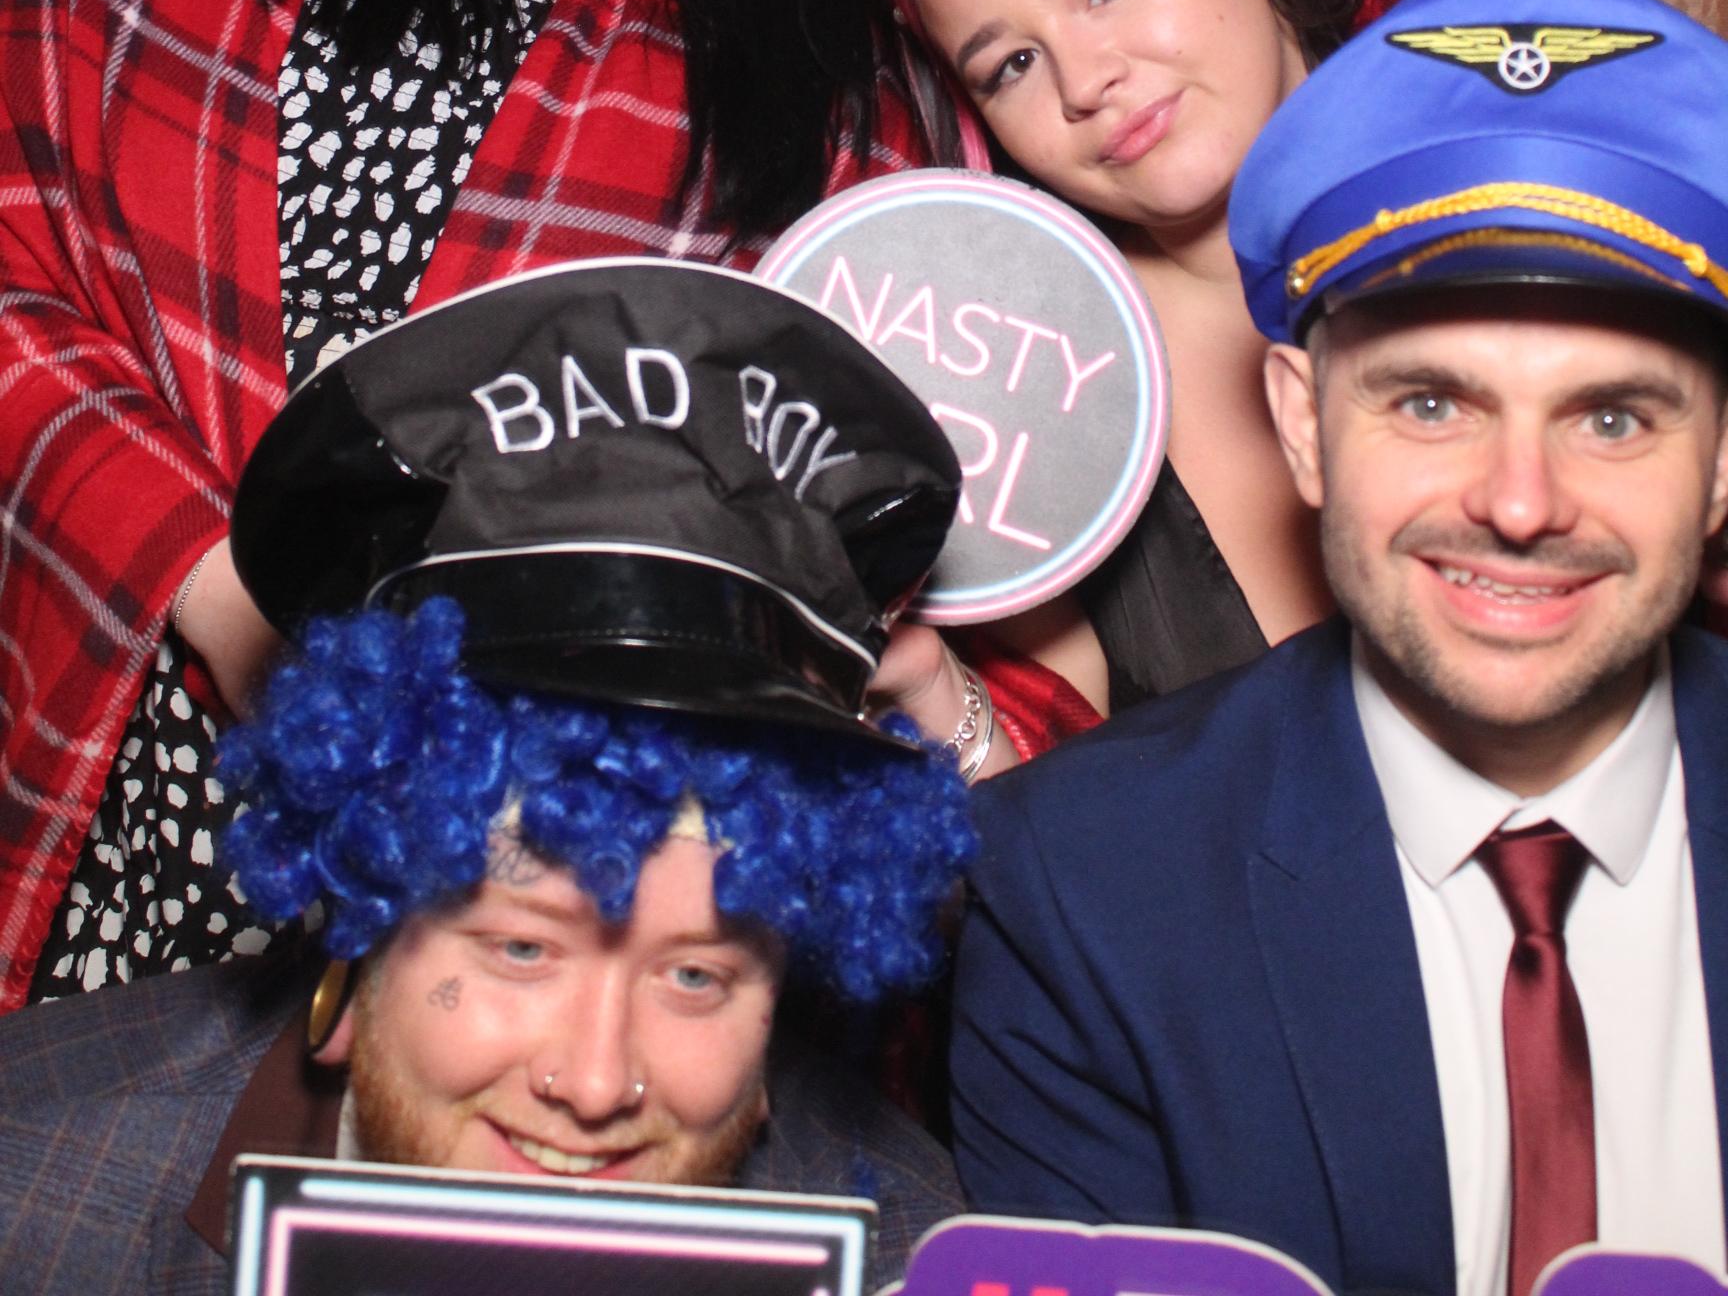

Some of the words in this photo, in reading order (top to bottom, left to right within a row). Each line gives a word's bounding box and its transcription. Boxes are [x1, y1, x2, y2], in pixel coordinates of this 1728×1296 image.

[820, 255, 1116, 413] NASTY
[471, 347, 690, 454] BAD
[738, 364, 858, 502] BOY
[929, 402, 1052, 550] RL
